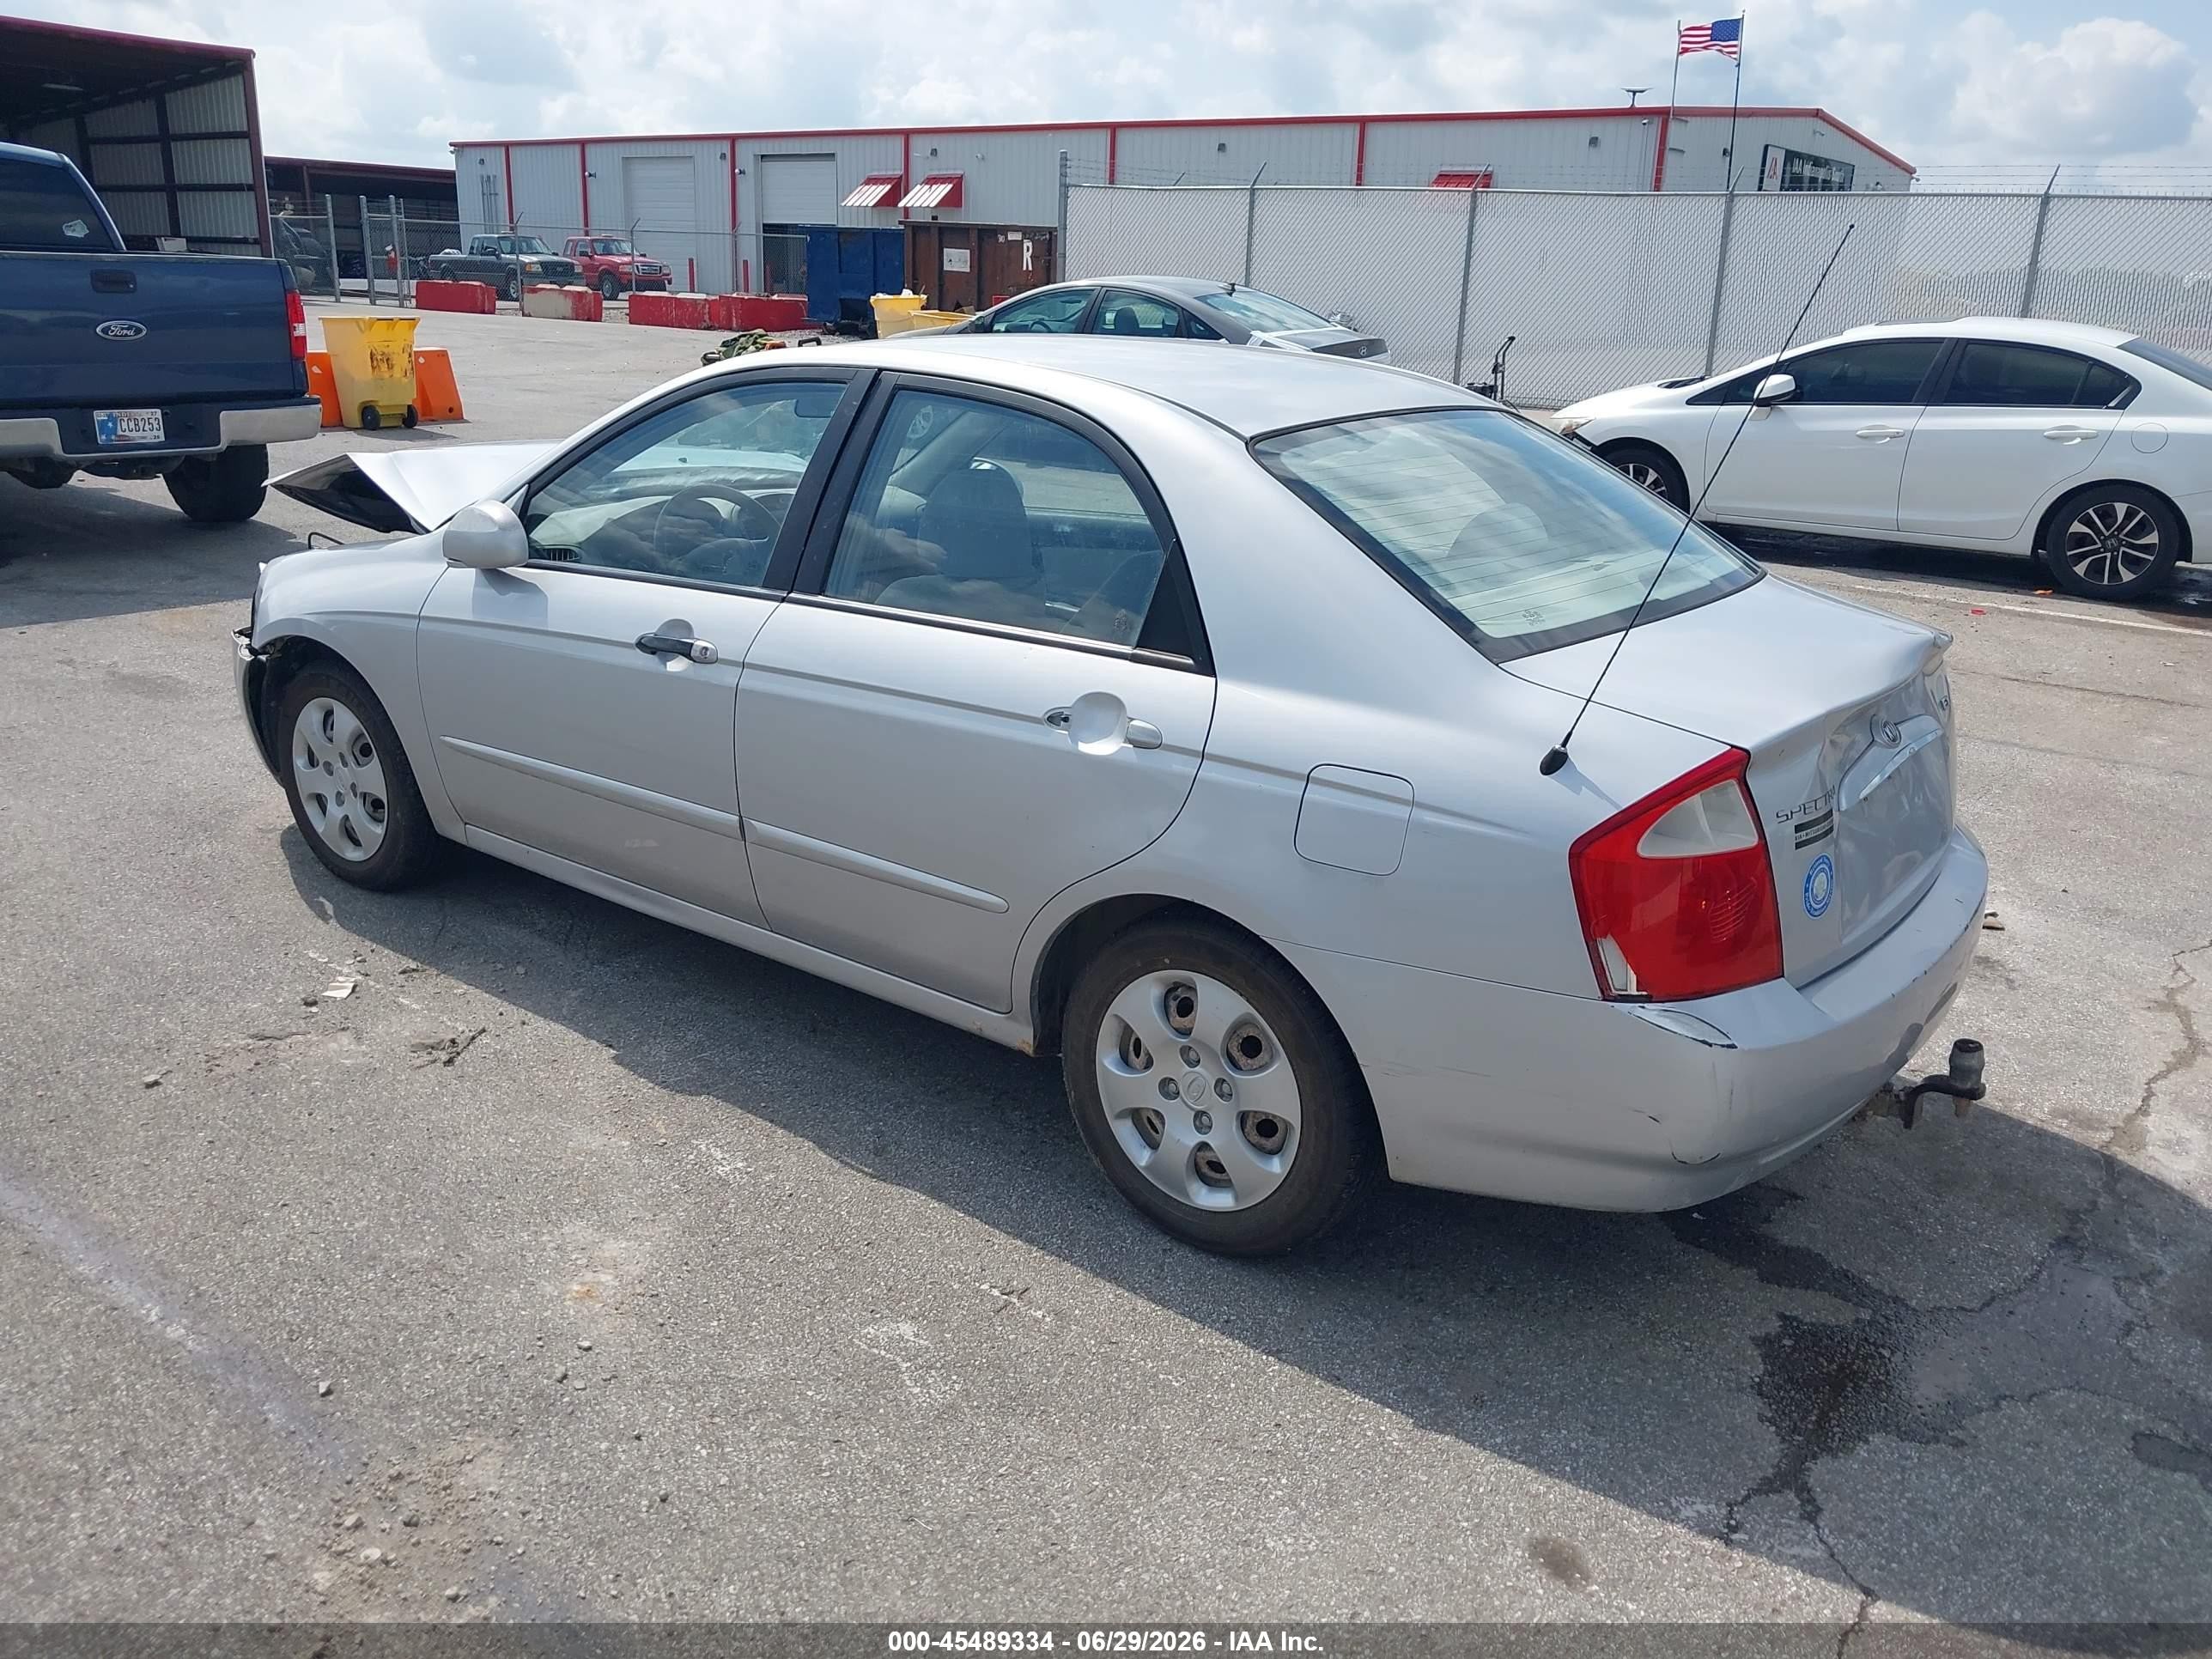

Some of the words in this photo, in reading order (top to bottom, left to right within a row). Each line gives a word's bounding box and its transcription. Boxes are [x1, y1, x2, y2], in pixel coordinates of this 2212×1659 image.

[1023, 240, 1033, 271] R
[108, 325, 136, 336] Ford
[119, 416, 161, 433] CCB253
[1776, 784, 1836, 824] SPECTRA
